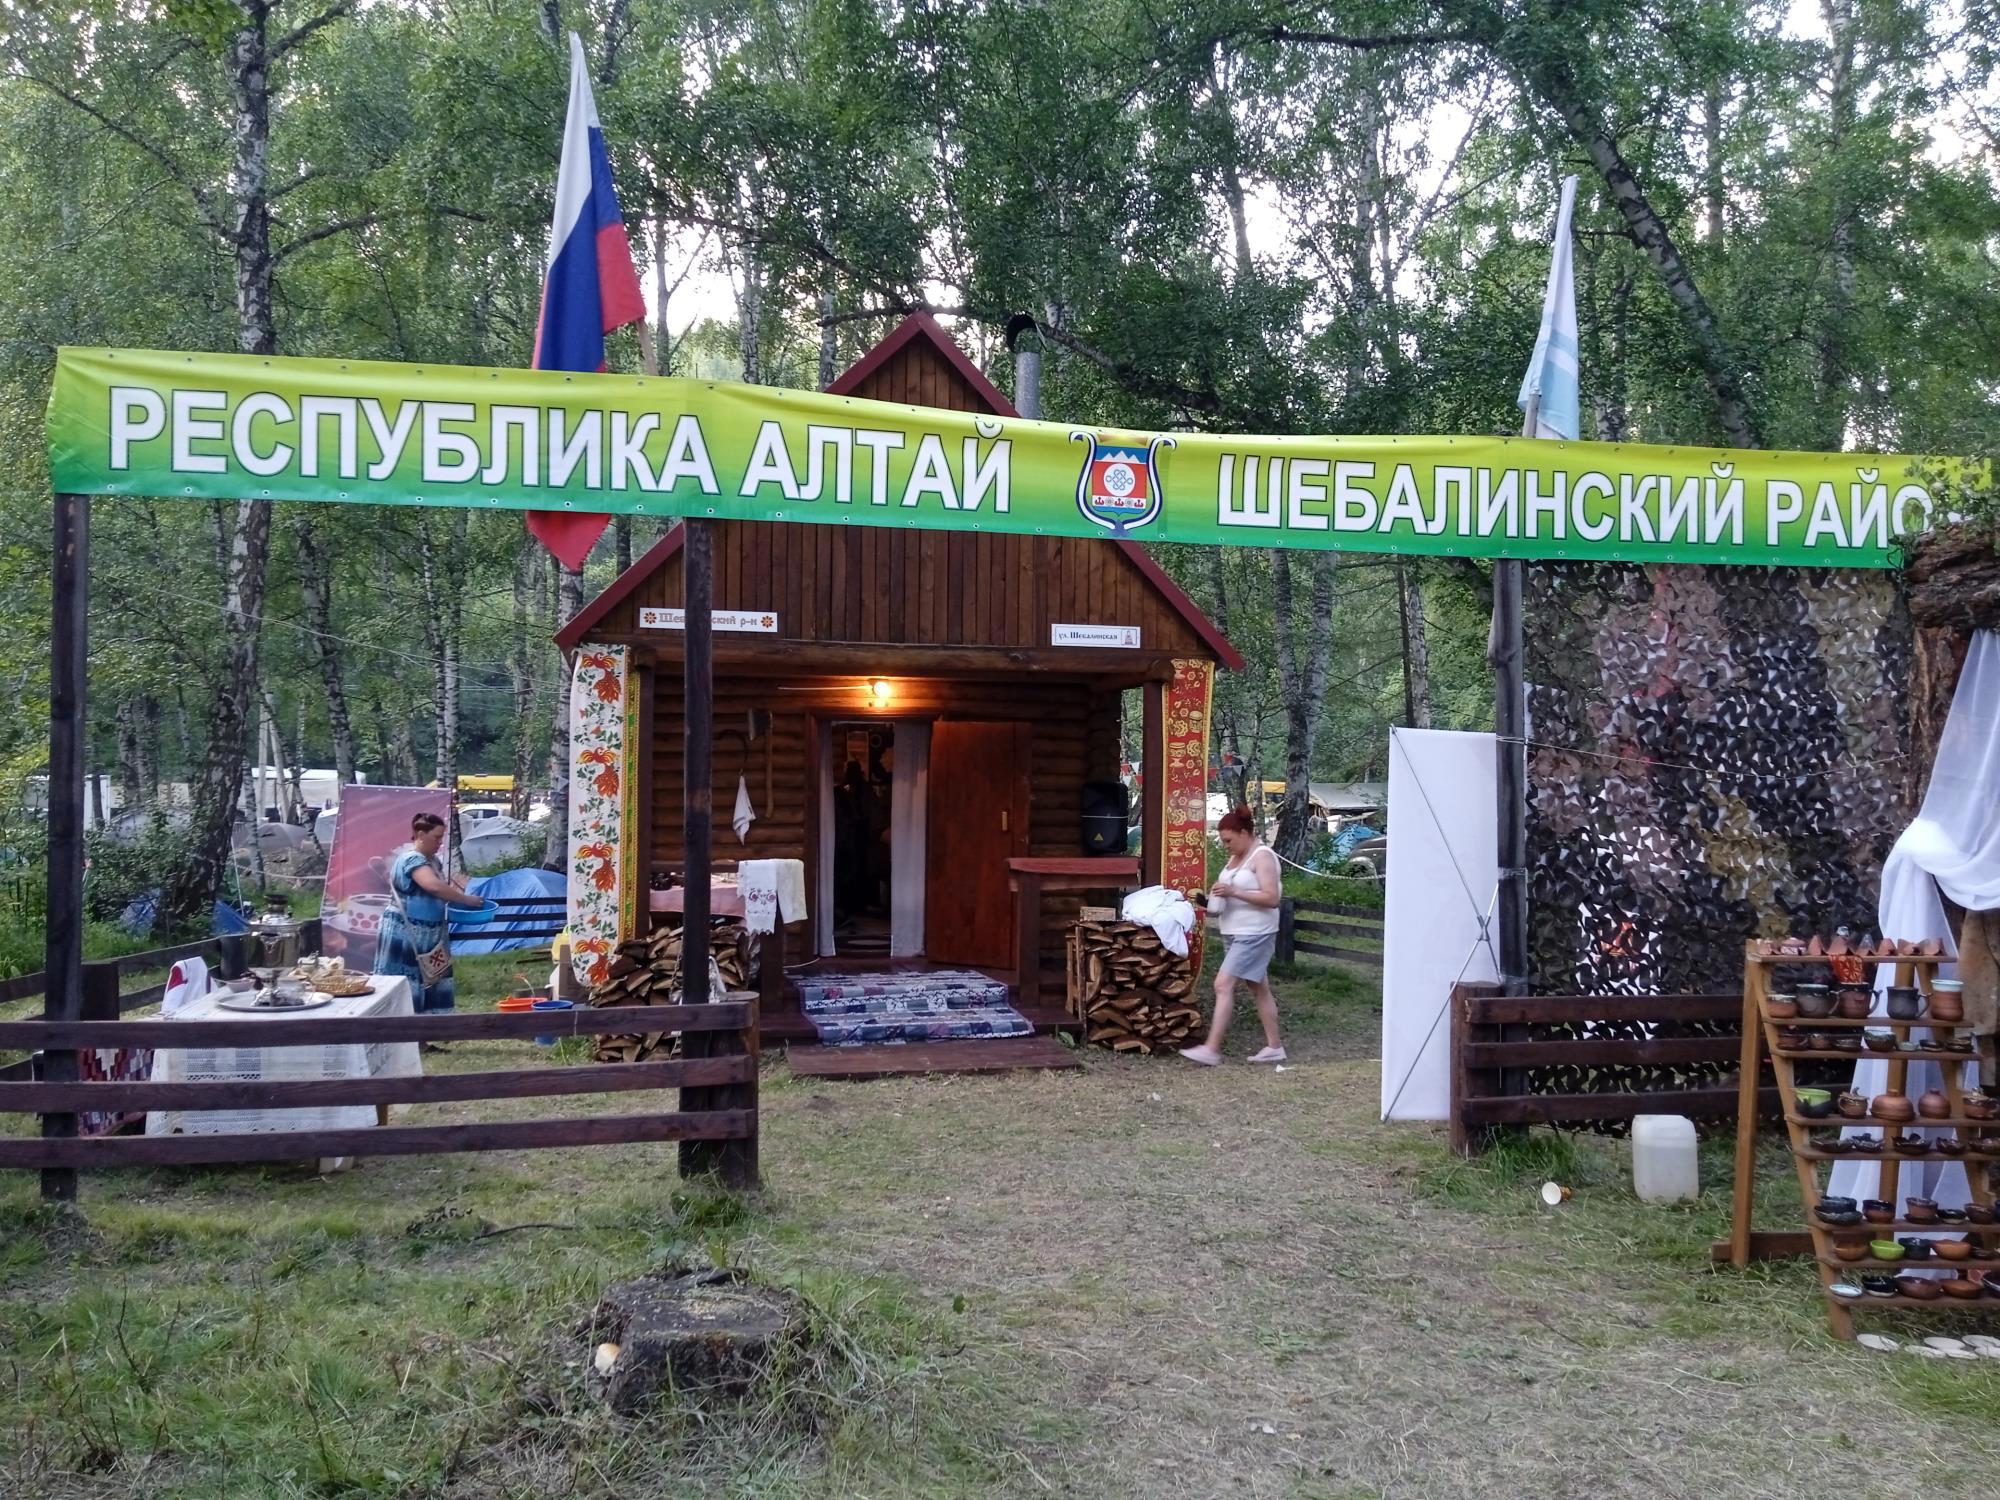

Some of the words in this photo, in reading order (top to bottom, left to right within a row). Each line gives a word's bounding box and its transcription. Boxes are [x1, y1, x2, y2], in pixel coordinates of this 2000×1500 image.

[109, 385, 721, 496] РЕСПУБЛИКА
[737, 419, 1014, 514] АЛТАЙ
[1216, 453, 1746, 546] ШЕБАЛИНСКИЙ
[1765, 467, 1937, 549] РАЙО
